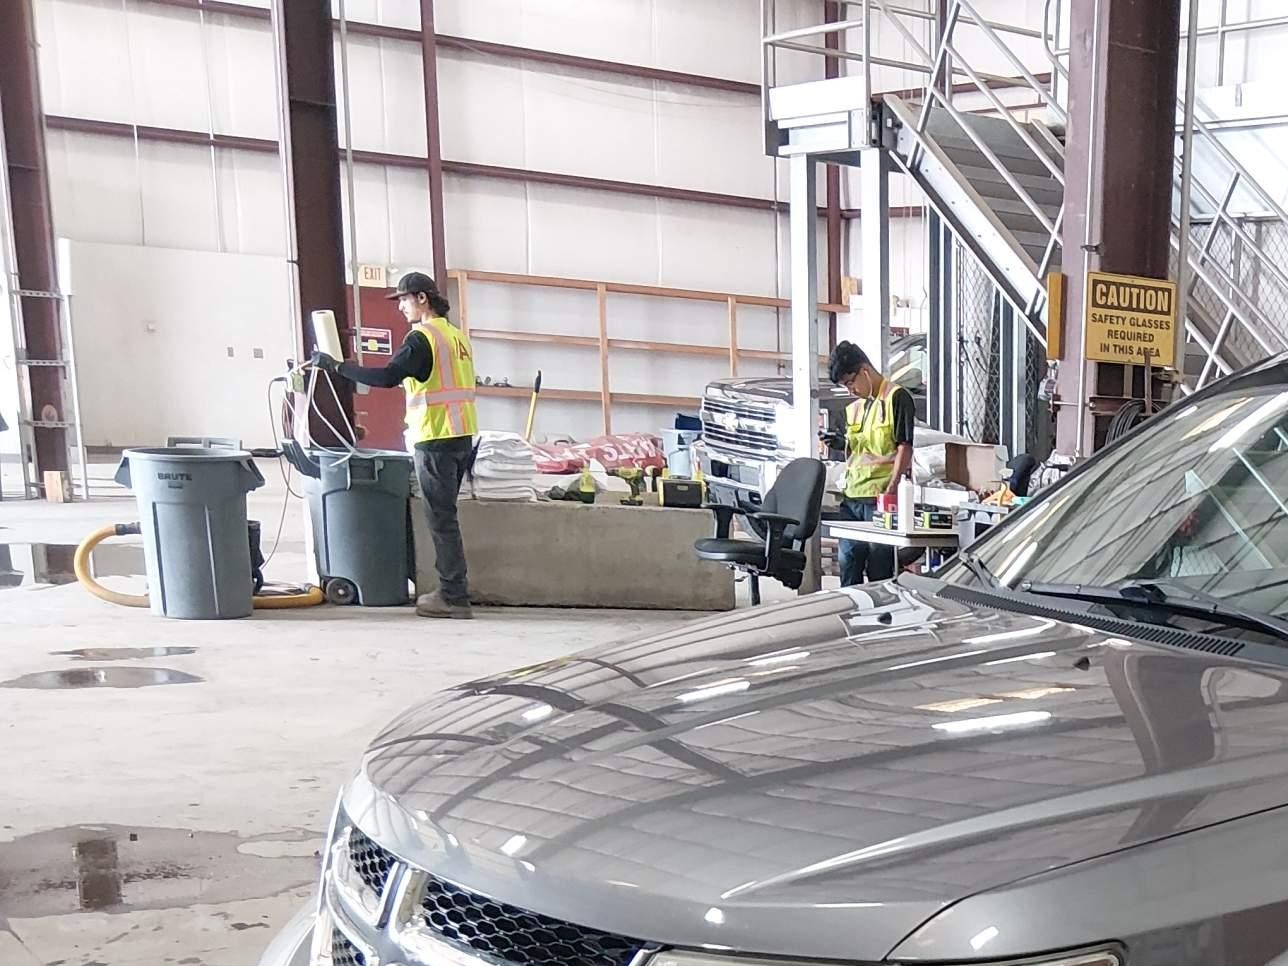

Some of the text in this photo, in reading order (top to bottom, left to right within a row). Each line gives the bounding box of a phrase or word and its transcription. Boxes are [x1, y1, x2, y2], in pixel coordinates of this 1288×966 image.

[363, 267, 381, 280] EXIT
[1095, 283, 1169, 312] CAUTION
[1091, 312, 1171, 330] SAFETY GLASSES
[1107, 329, 1154, 343] REQUIRED
[1100, 343, 1110, 353] IN
[1113, 344, 1134, 355] THIS
